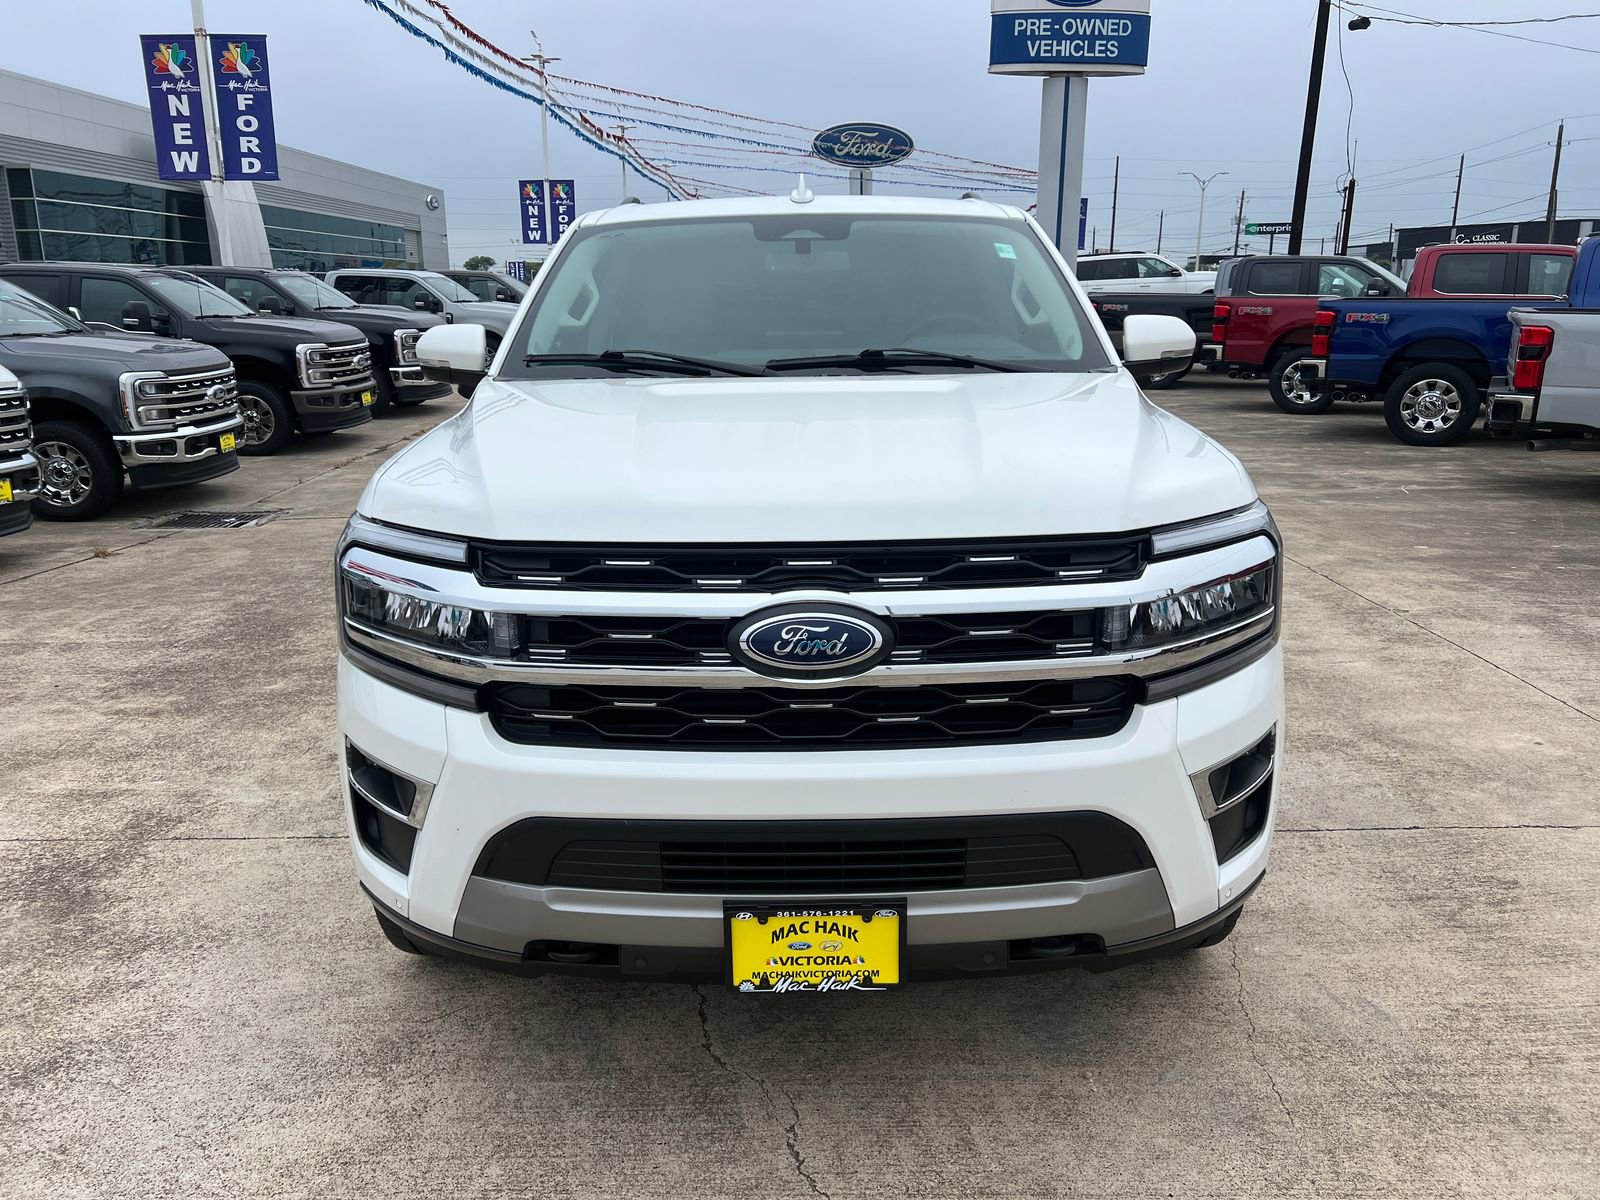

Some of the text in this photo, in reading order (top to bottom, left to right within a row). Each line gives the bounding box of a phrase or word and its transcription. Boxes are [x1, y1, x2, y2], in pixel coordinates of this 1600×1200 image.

[1014, 18, 1132, 36] PRE-OWNED
[1027, 40, 1119, 57] VEHICLES
[167, 95, 198, 172] NEW
[236, 94, 261, 173] FORD
[834, 130, 894, 159] Ford
[528, 206, 541, 240] NEW
[558, 206, 569, 233] FOR
[1238, 306, 1273, 315] FX4
[1345, 313, 1390, 324] FX4
[773, 625, 849, 656] Ford
[771, 920, 859, 944] MAC HAIK
[778, 955, 852, 966] VICTORIA
[752, 969, 880, 979] MACHAIKVICTORIACOM
[772, 975, 864, 993] Mac Haik
